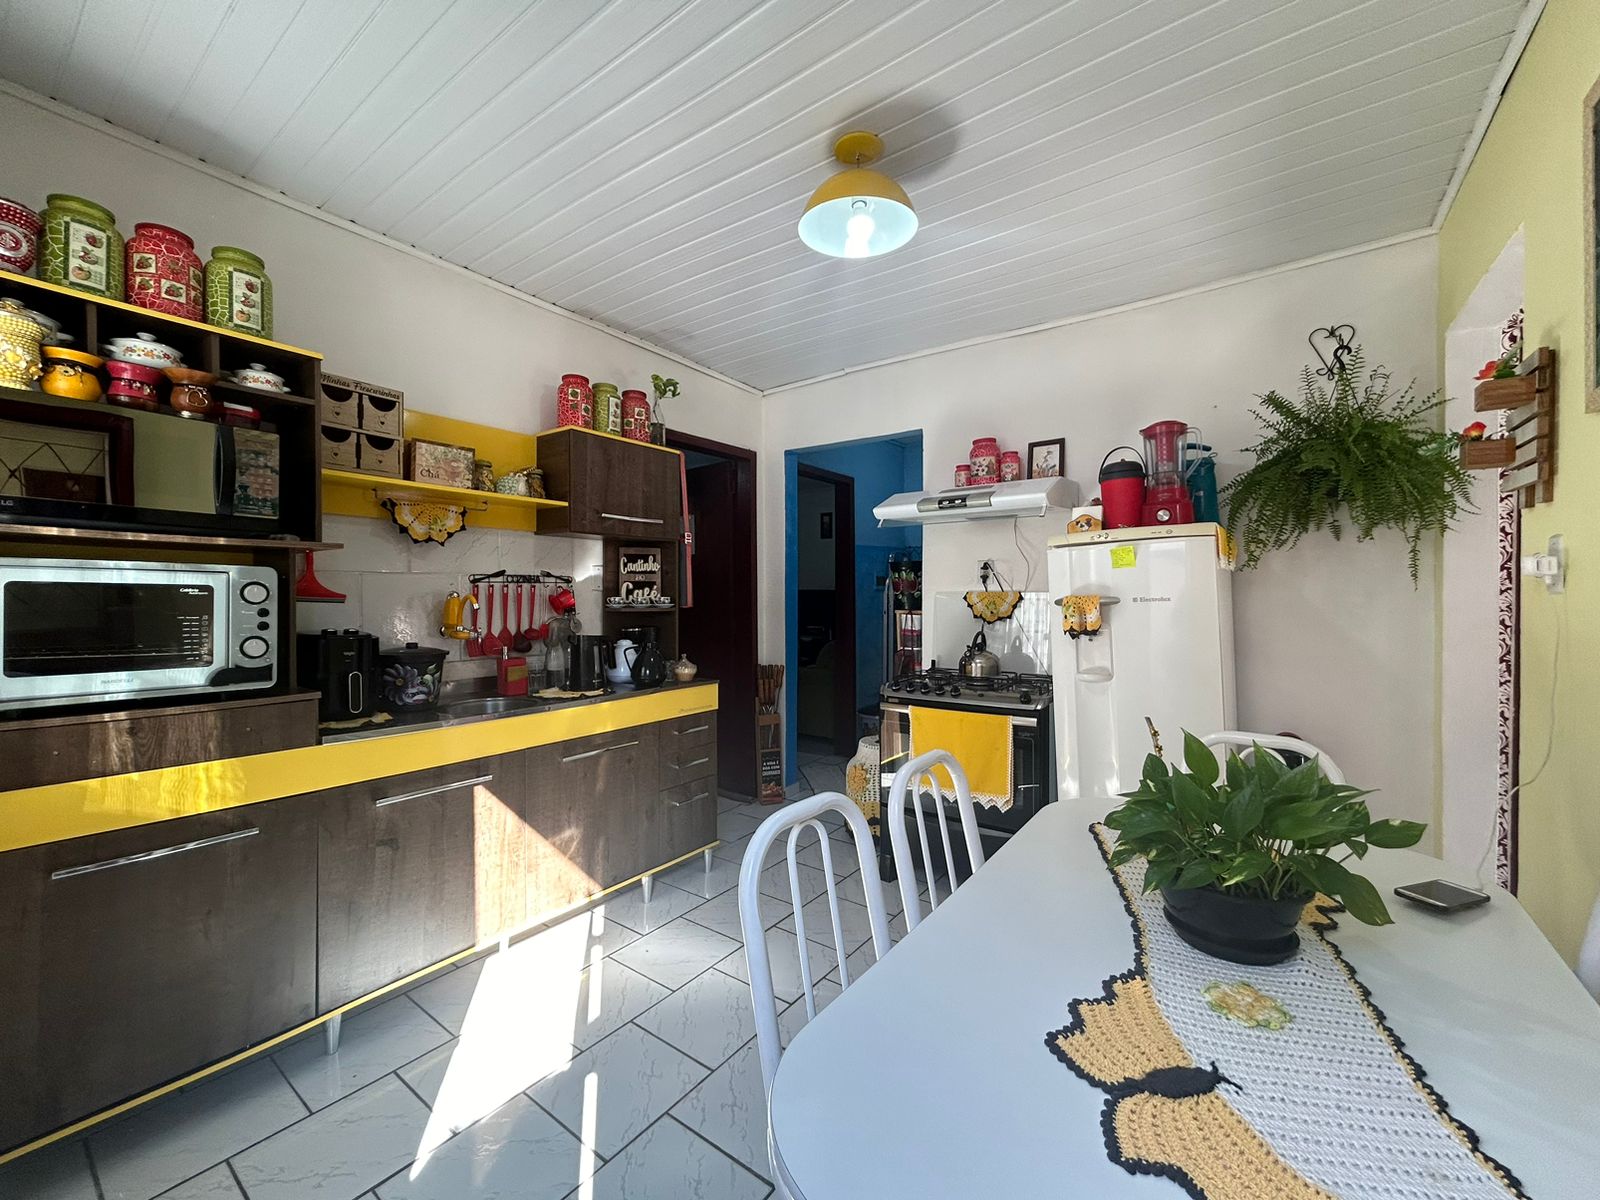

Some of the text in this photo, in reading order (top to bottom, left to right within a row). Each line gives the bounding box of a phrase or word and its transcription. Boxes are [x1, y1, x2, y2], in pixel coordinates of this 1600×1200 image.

[420, 468, 440, 479] Chá
[620, 555, 660, 574] Cantinho
[506, 574, 541, 584] COZINHA
[621, 581, 661, 603] Café
